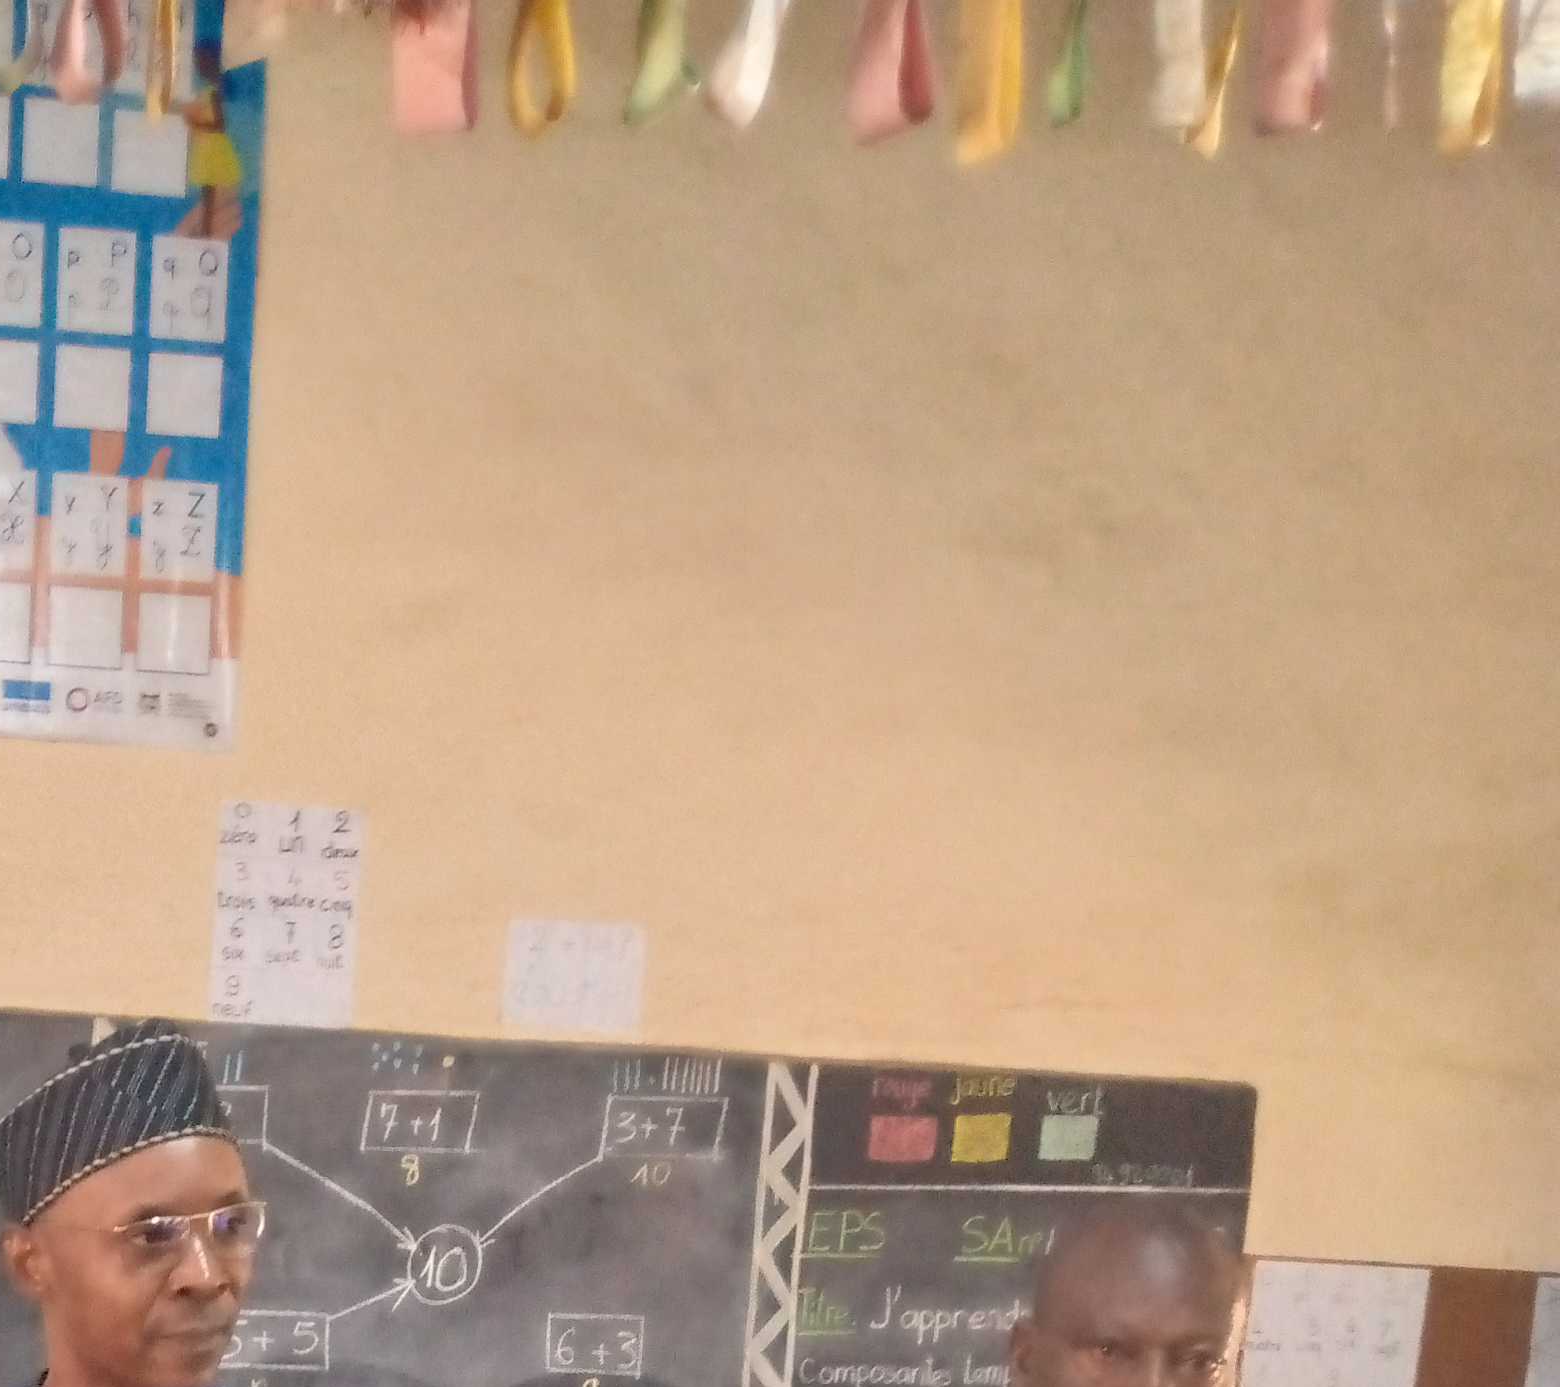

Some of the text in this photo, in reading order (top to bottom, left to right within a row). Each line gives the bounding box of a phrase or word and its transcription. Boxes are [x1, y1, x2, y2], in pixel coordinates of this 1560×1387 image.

[333, 810, 350, 833] 2
[951, 1076, 1016, 1105] jaune
[1047, 1086, 1105, 1116] vert
[808, 1211, 885, 1252] EPS
[419, 1245, 468, 1291] 10
